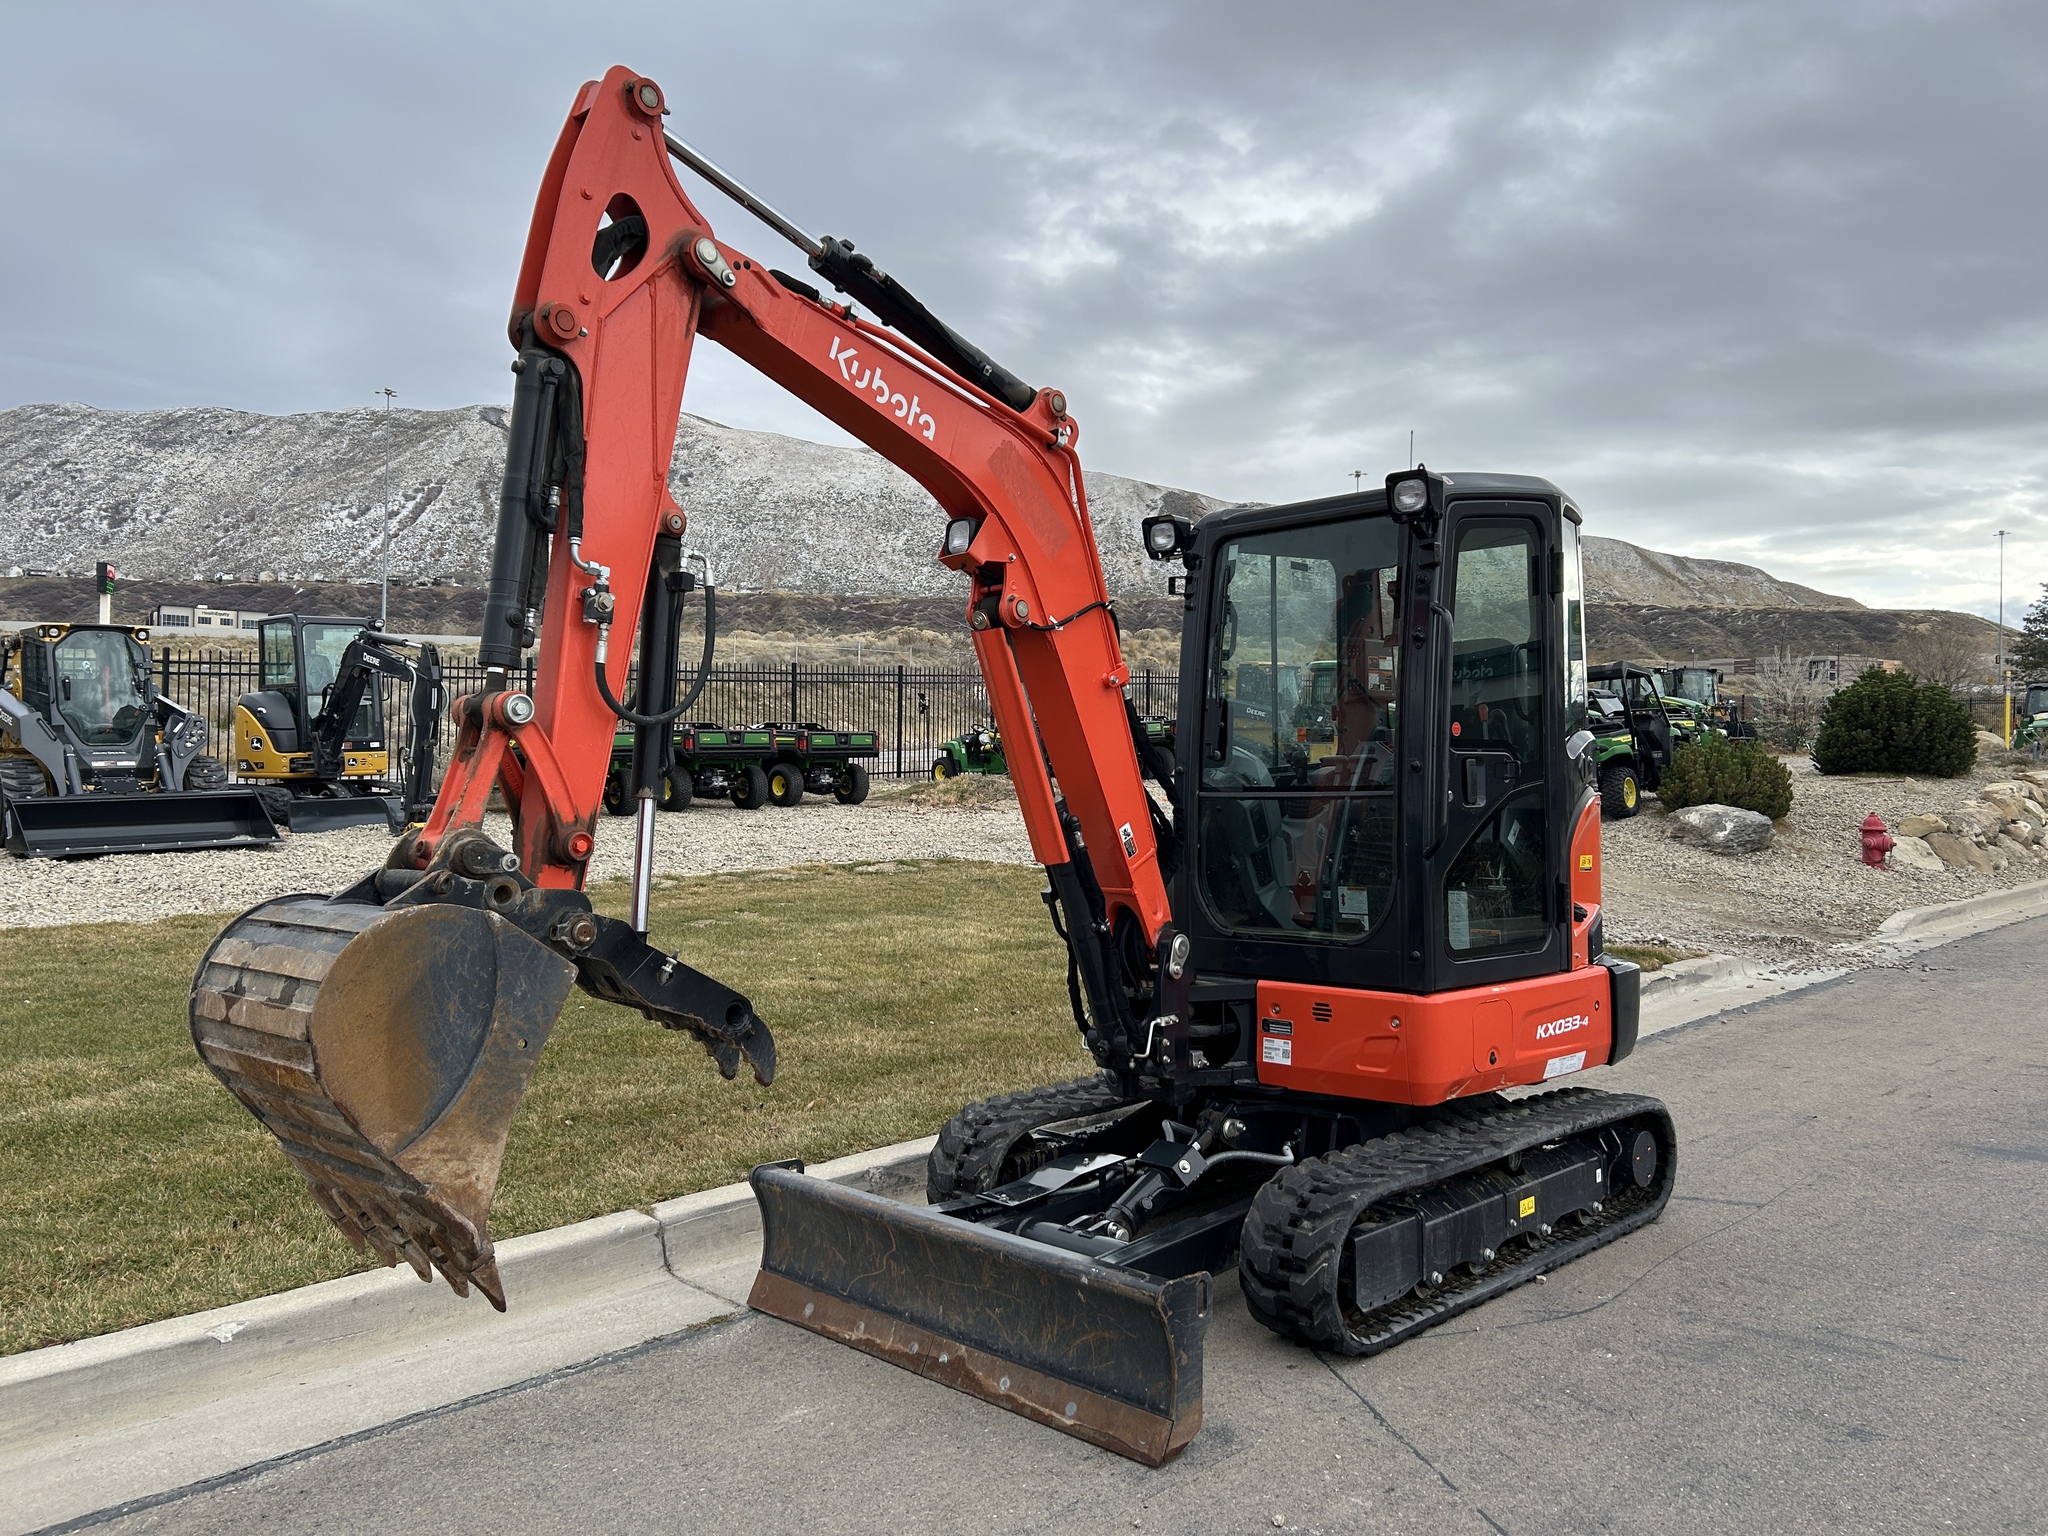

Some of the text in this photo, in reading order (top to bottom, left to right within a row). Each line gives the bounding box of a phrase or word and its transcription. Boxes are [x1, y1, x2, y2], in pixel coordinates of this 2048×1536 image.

[829, 335, 936, 441] Kubota
[362, 652, 381, 667] DEERE
[1453, 664, 1494, 679] ubota
[1246, 707, 1267, 717] DEERE
[1536, 1014, 1589, 1040] KX033-4
